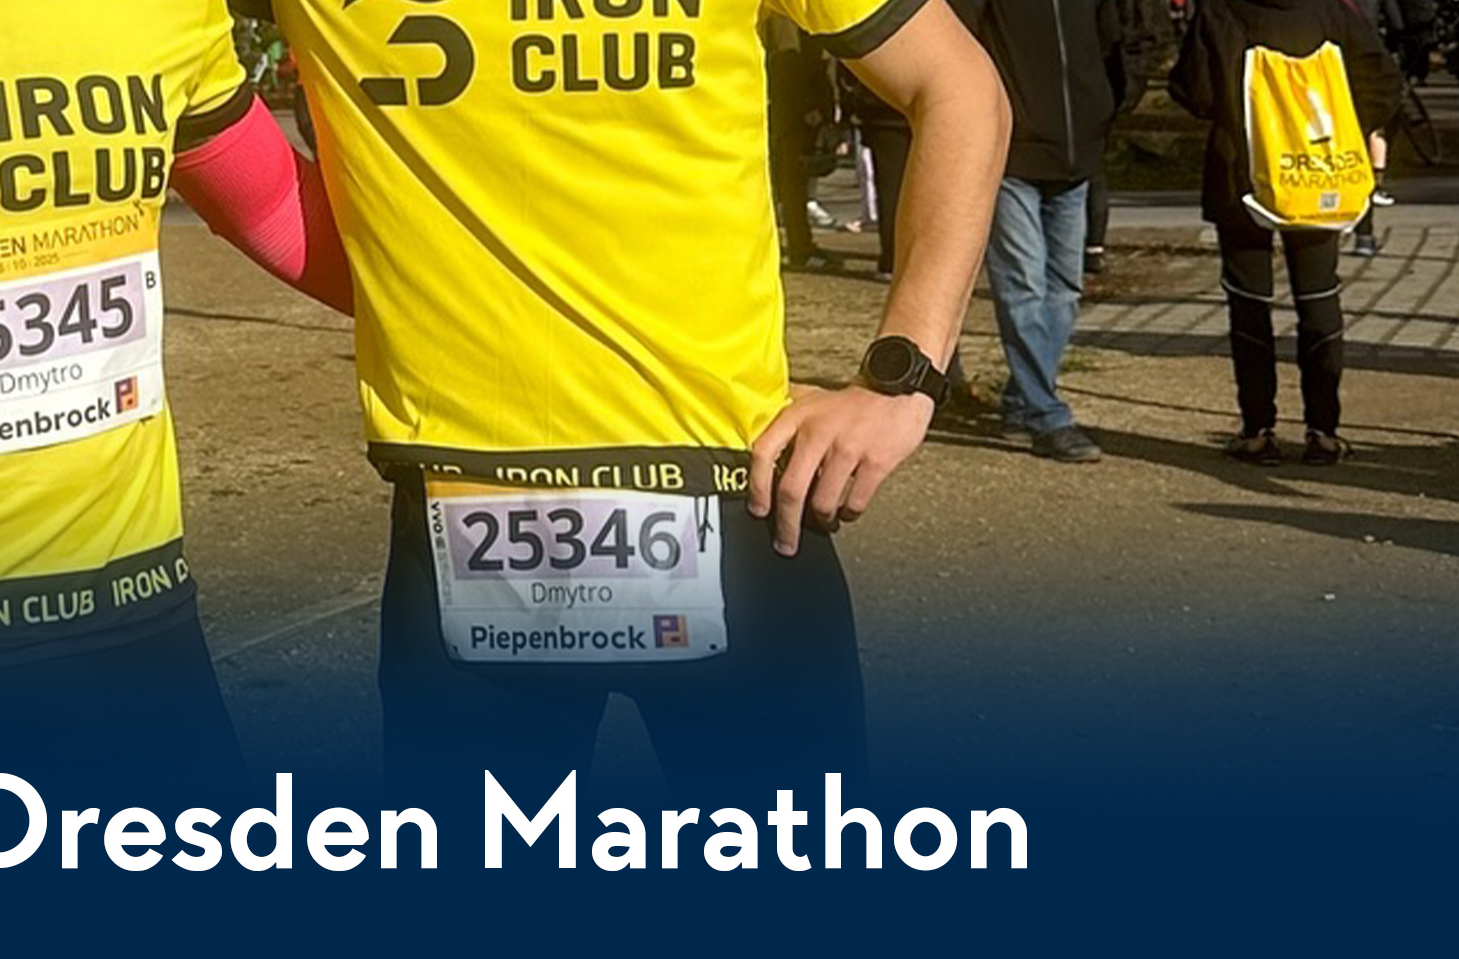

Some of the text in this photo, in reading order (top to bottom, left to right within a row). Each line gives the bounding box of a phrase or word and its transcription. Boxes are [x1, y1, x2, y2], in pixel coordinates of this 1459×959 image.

[511, 32, 696, 93] CLUB
[32, 213, 140, 253] MARATHON
[145, 271, 157, 289] B
[462, 507, 682, 572] 25346
[22, 589, 95, 624] CLUB
[111, 569, 173, 608] IRON
[531, 581, 614, 608] Dmytro
[470, 624, 646, 655] Piepenbrock
